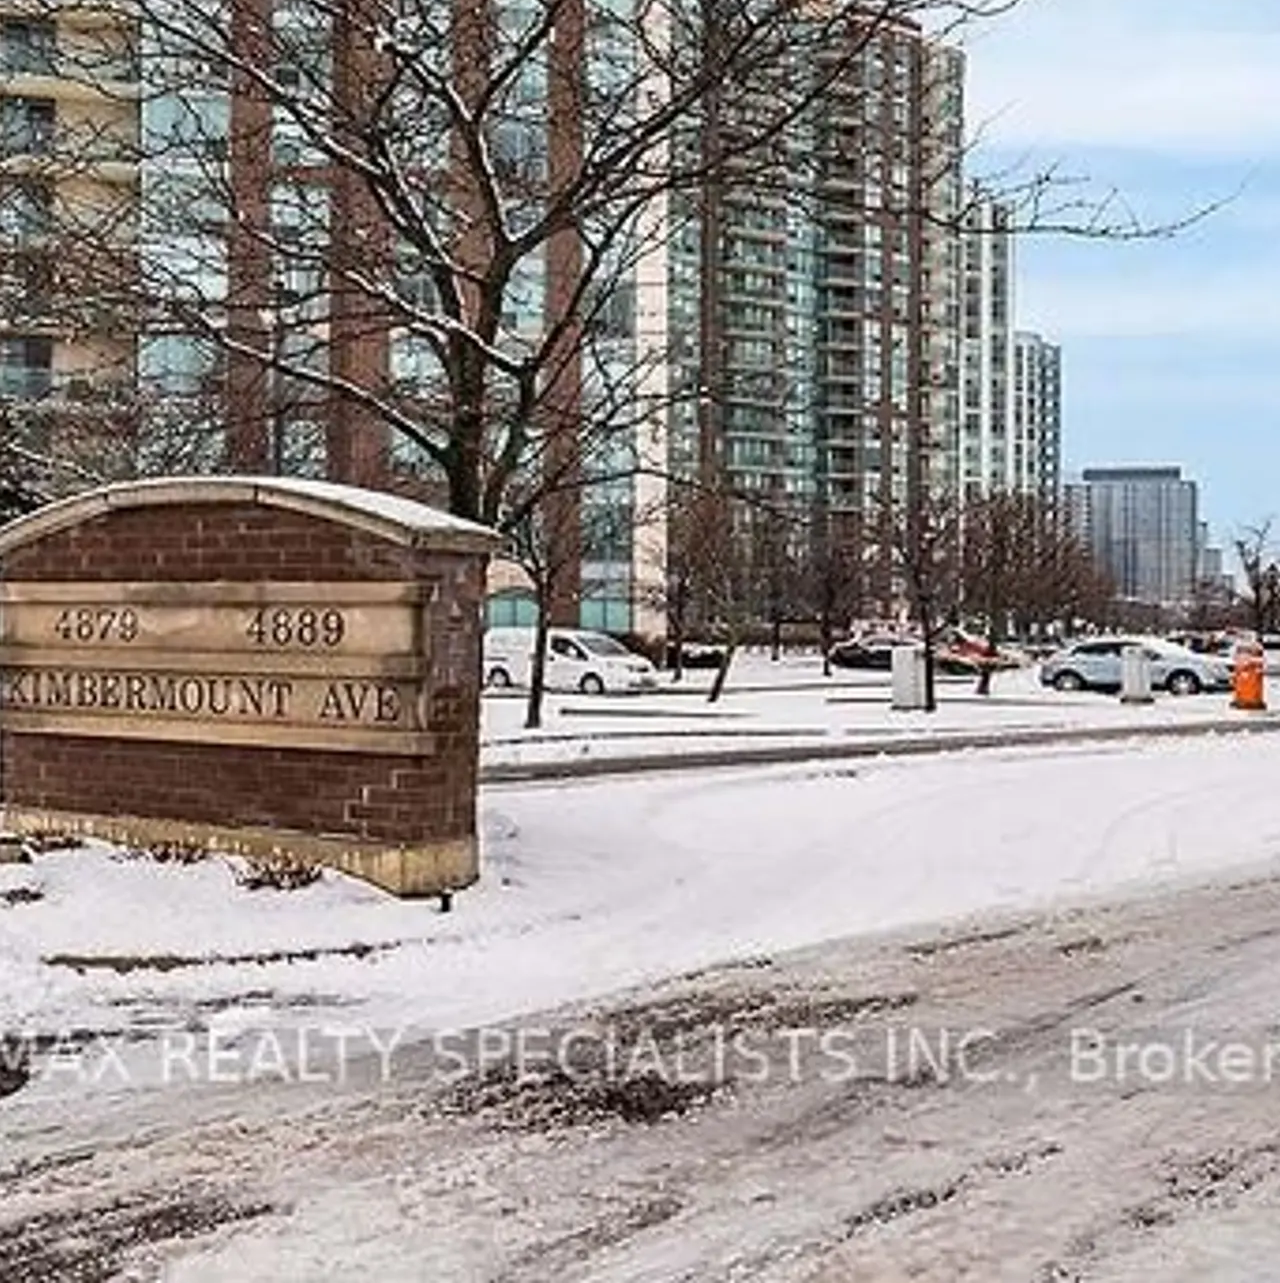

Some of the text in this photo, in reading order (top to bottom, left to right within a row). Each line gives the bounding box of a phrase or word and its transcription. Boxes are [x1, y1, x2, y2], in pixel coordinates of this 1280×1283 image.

[54, 607, 345, 647] 4879 4889
[8, 670, 401, 722] KIMBERMOUNT AVE
